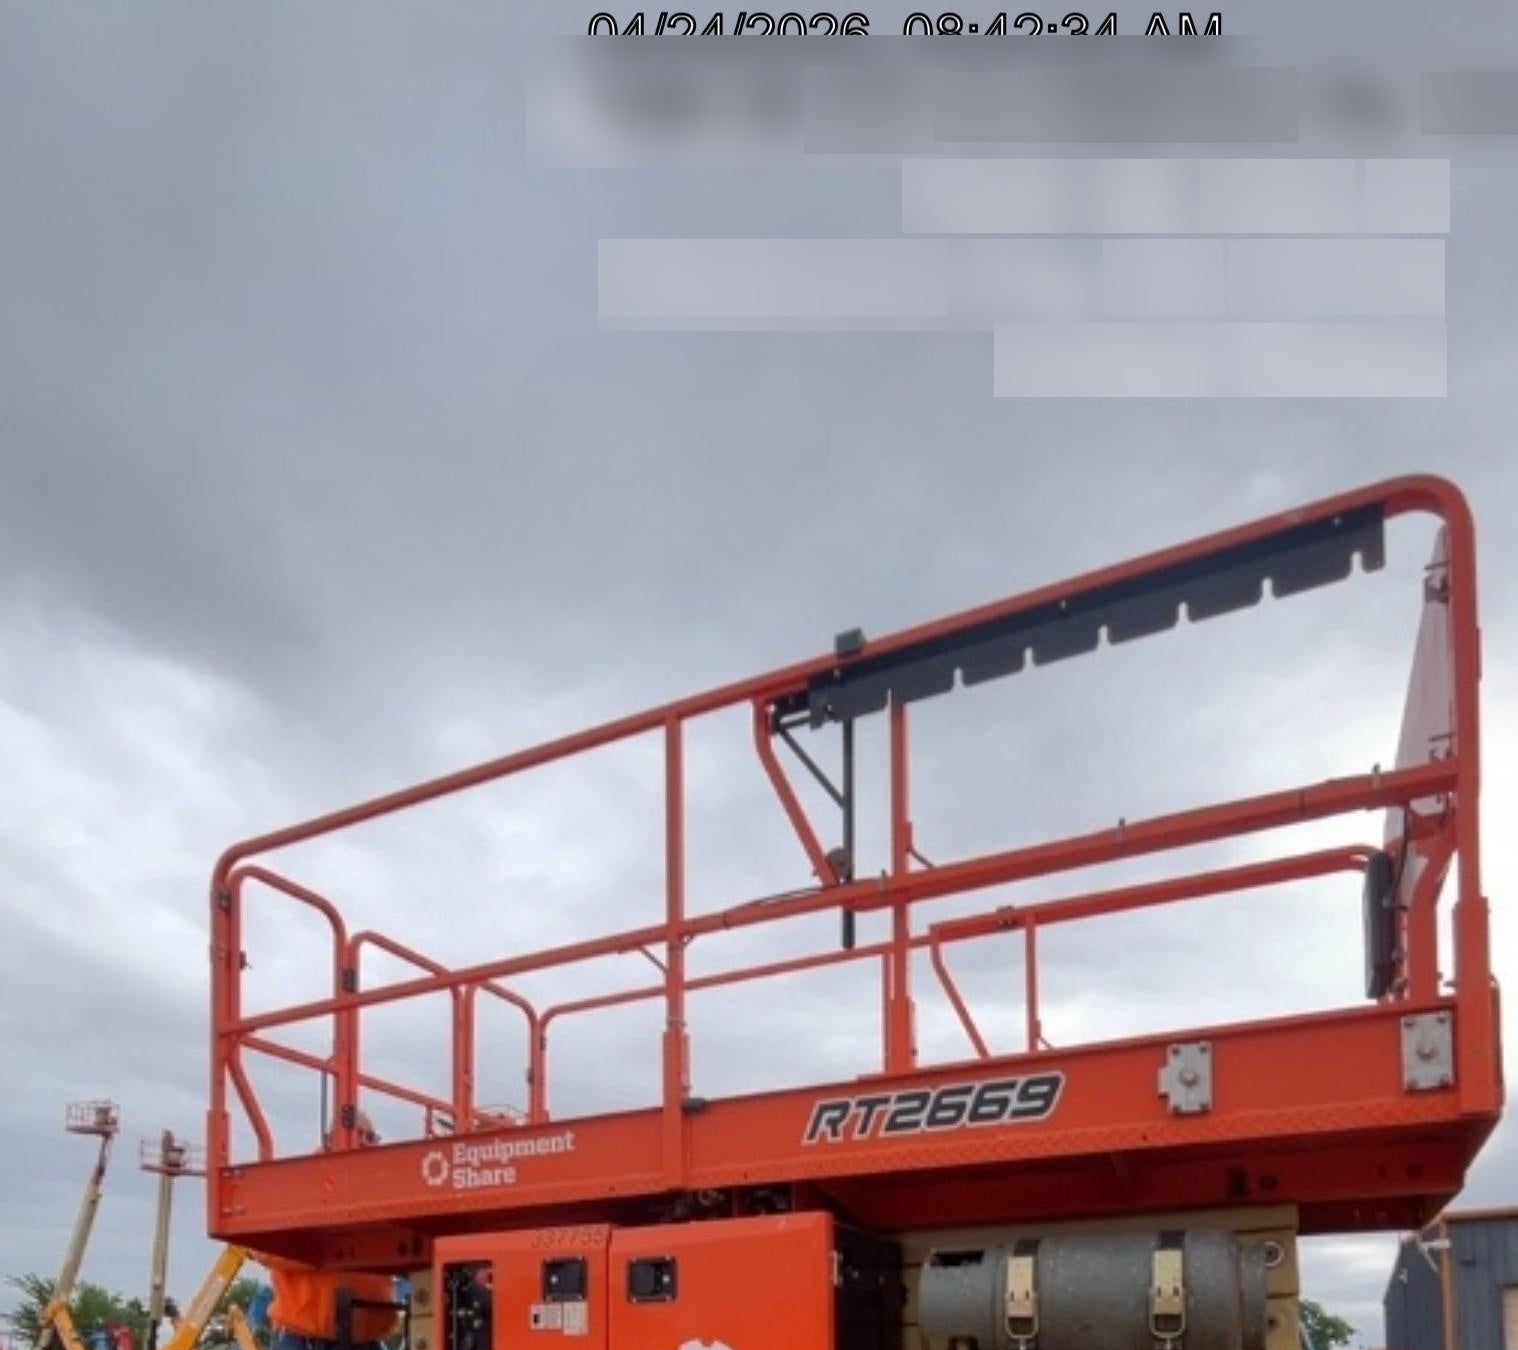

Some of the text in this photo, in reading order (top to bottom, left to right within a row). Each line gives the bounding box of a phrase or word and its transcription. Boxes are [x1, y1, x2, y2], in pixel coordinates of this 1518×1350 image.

[803, 1072, 1065, 1144] RT2669
[452, 1130, 576, 1167] Equipment
[452, 1166, 517, 1189] Share
